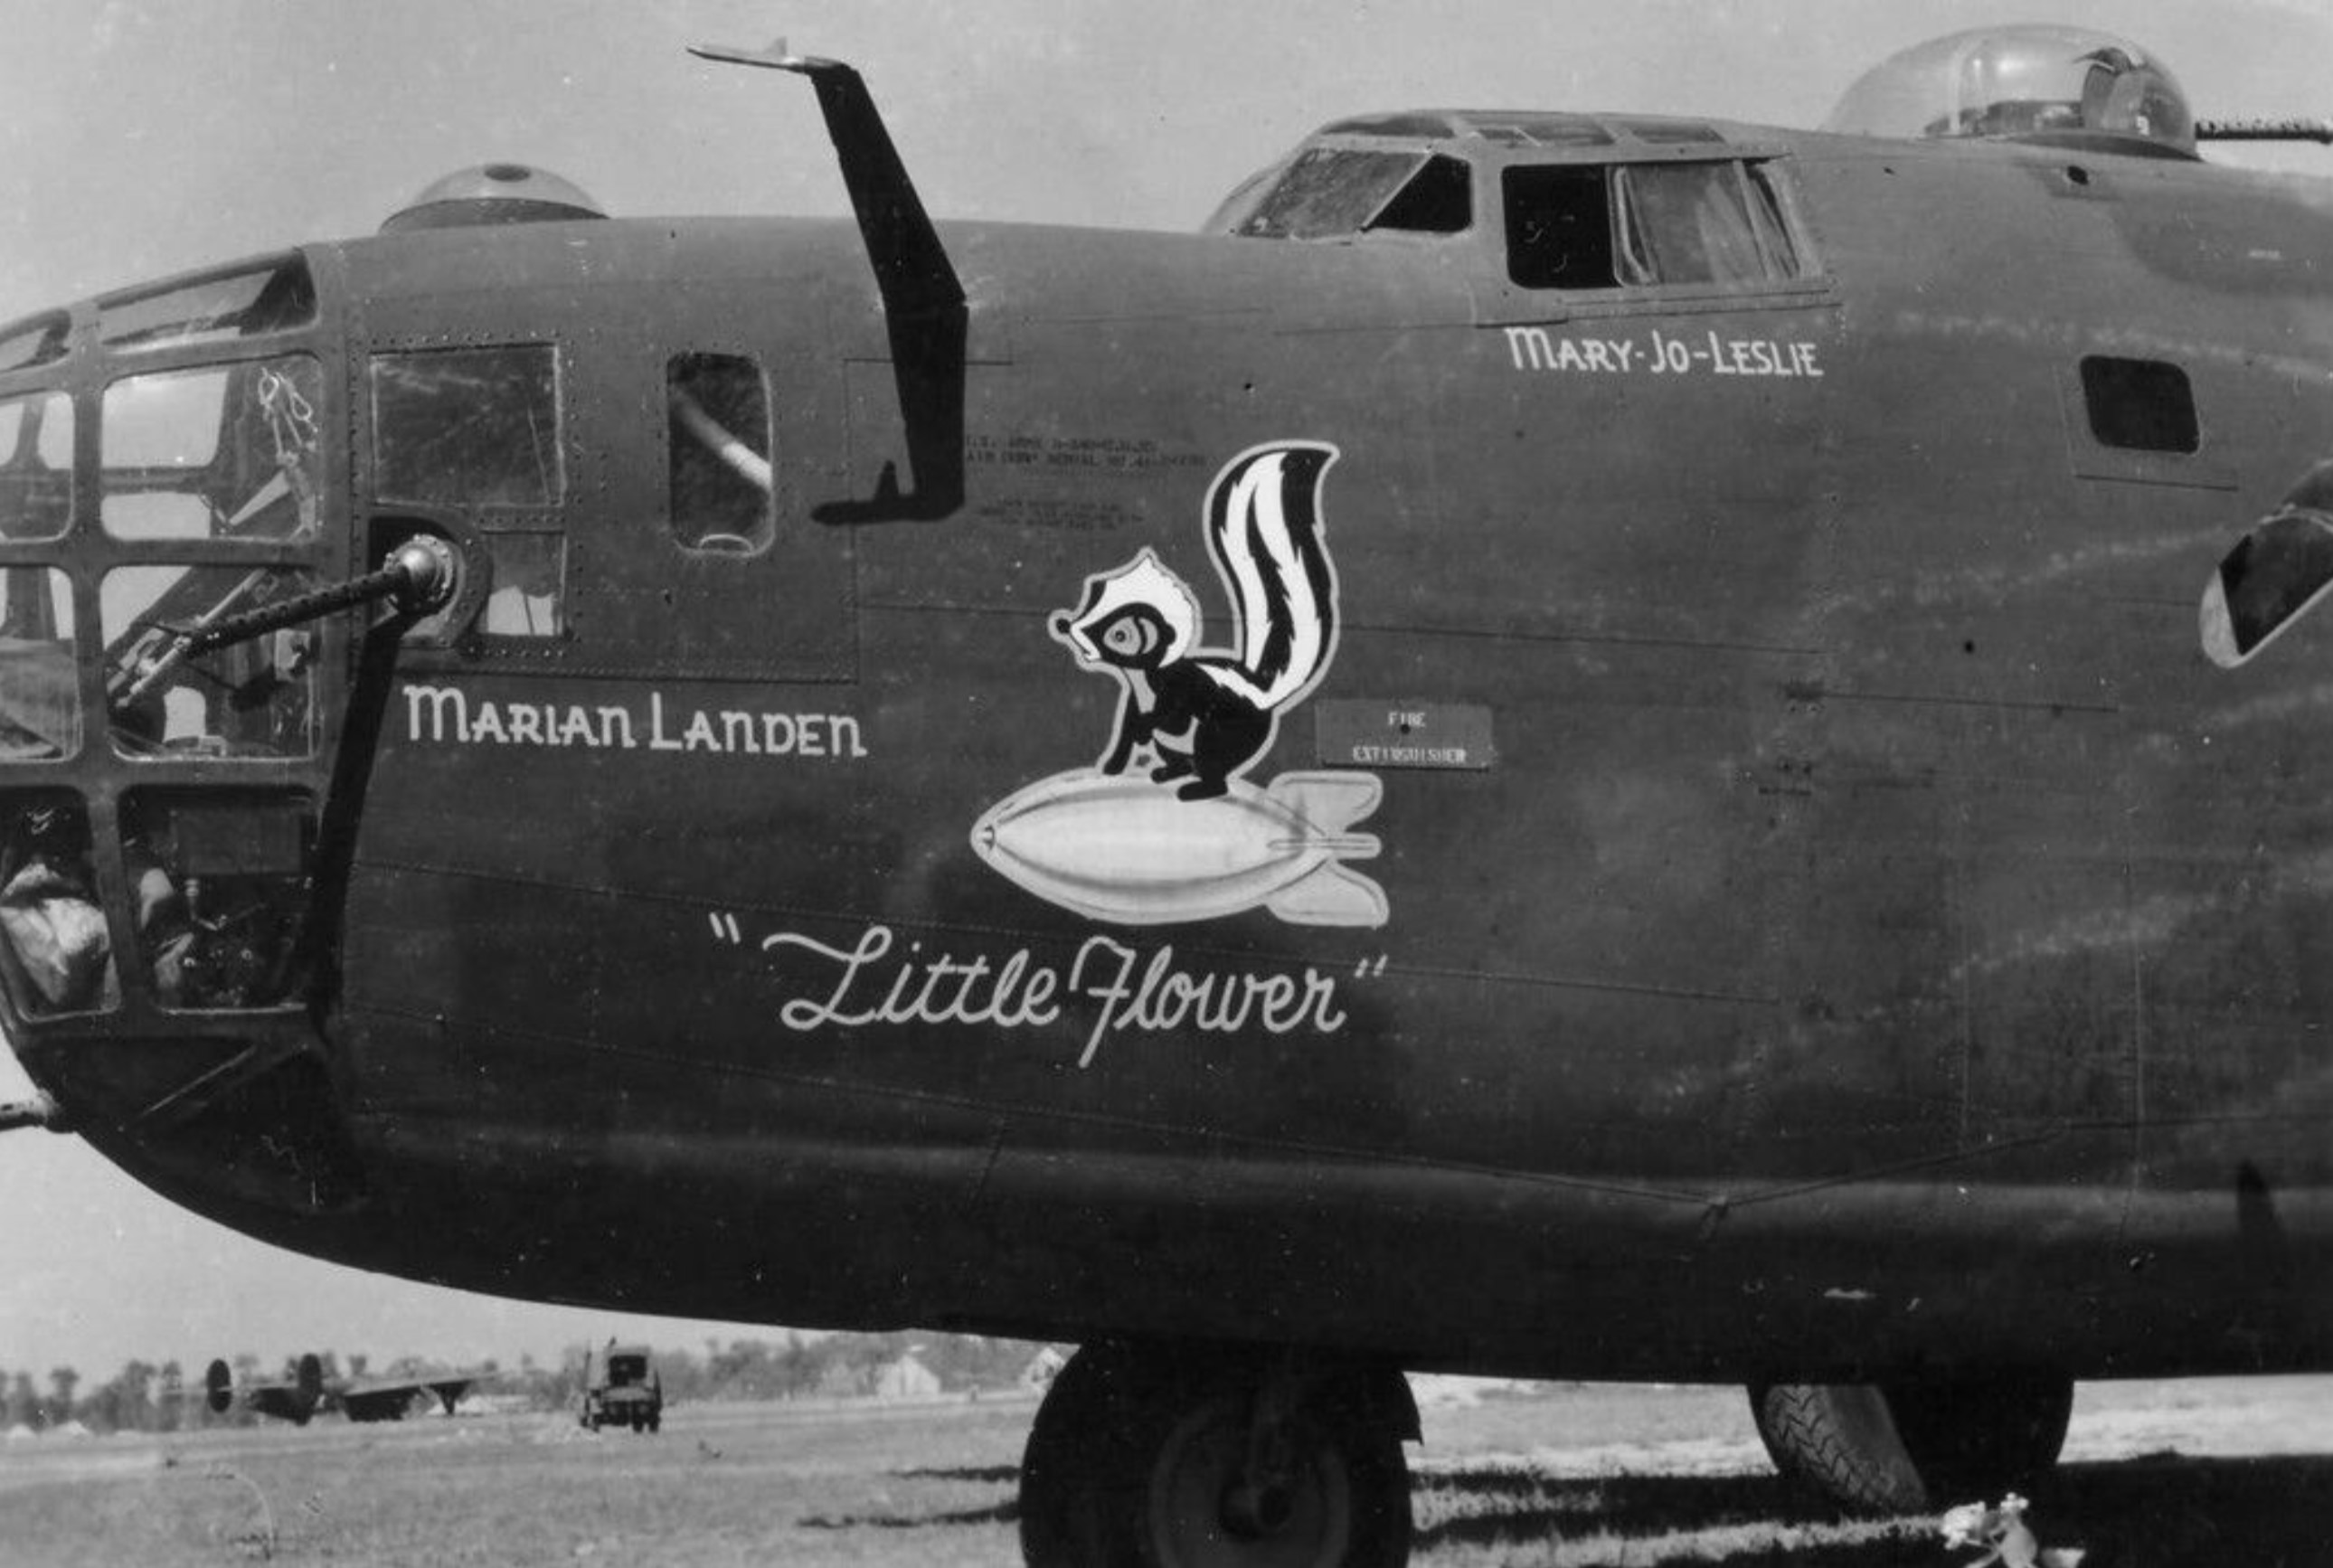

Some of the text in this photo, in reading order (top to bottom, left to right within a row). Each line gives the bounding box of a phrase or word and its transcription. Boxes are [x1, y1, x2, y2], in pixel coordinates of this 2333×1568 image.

[1503, 326, 1824, 377] MARY-JO-LESLIE
[402, 685, 868, 758] MARIAN LANDEN
[1387, 711, 1426, 728] FIRE
[1352, 745, 1468, 765] EXTINGUISHER
